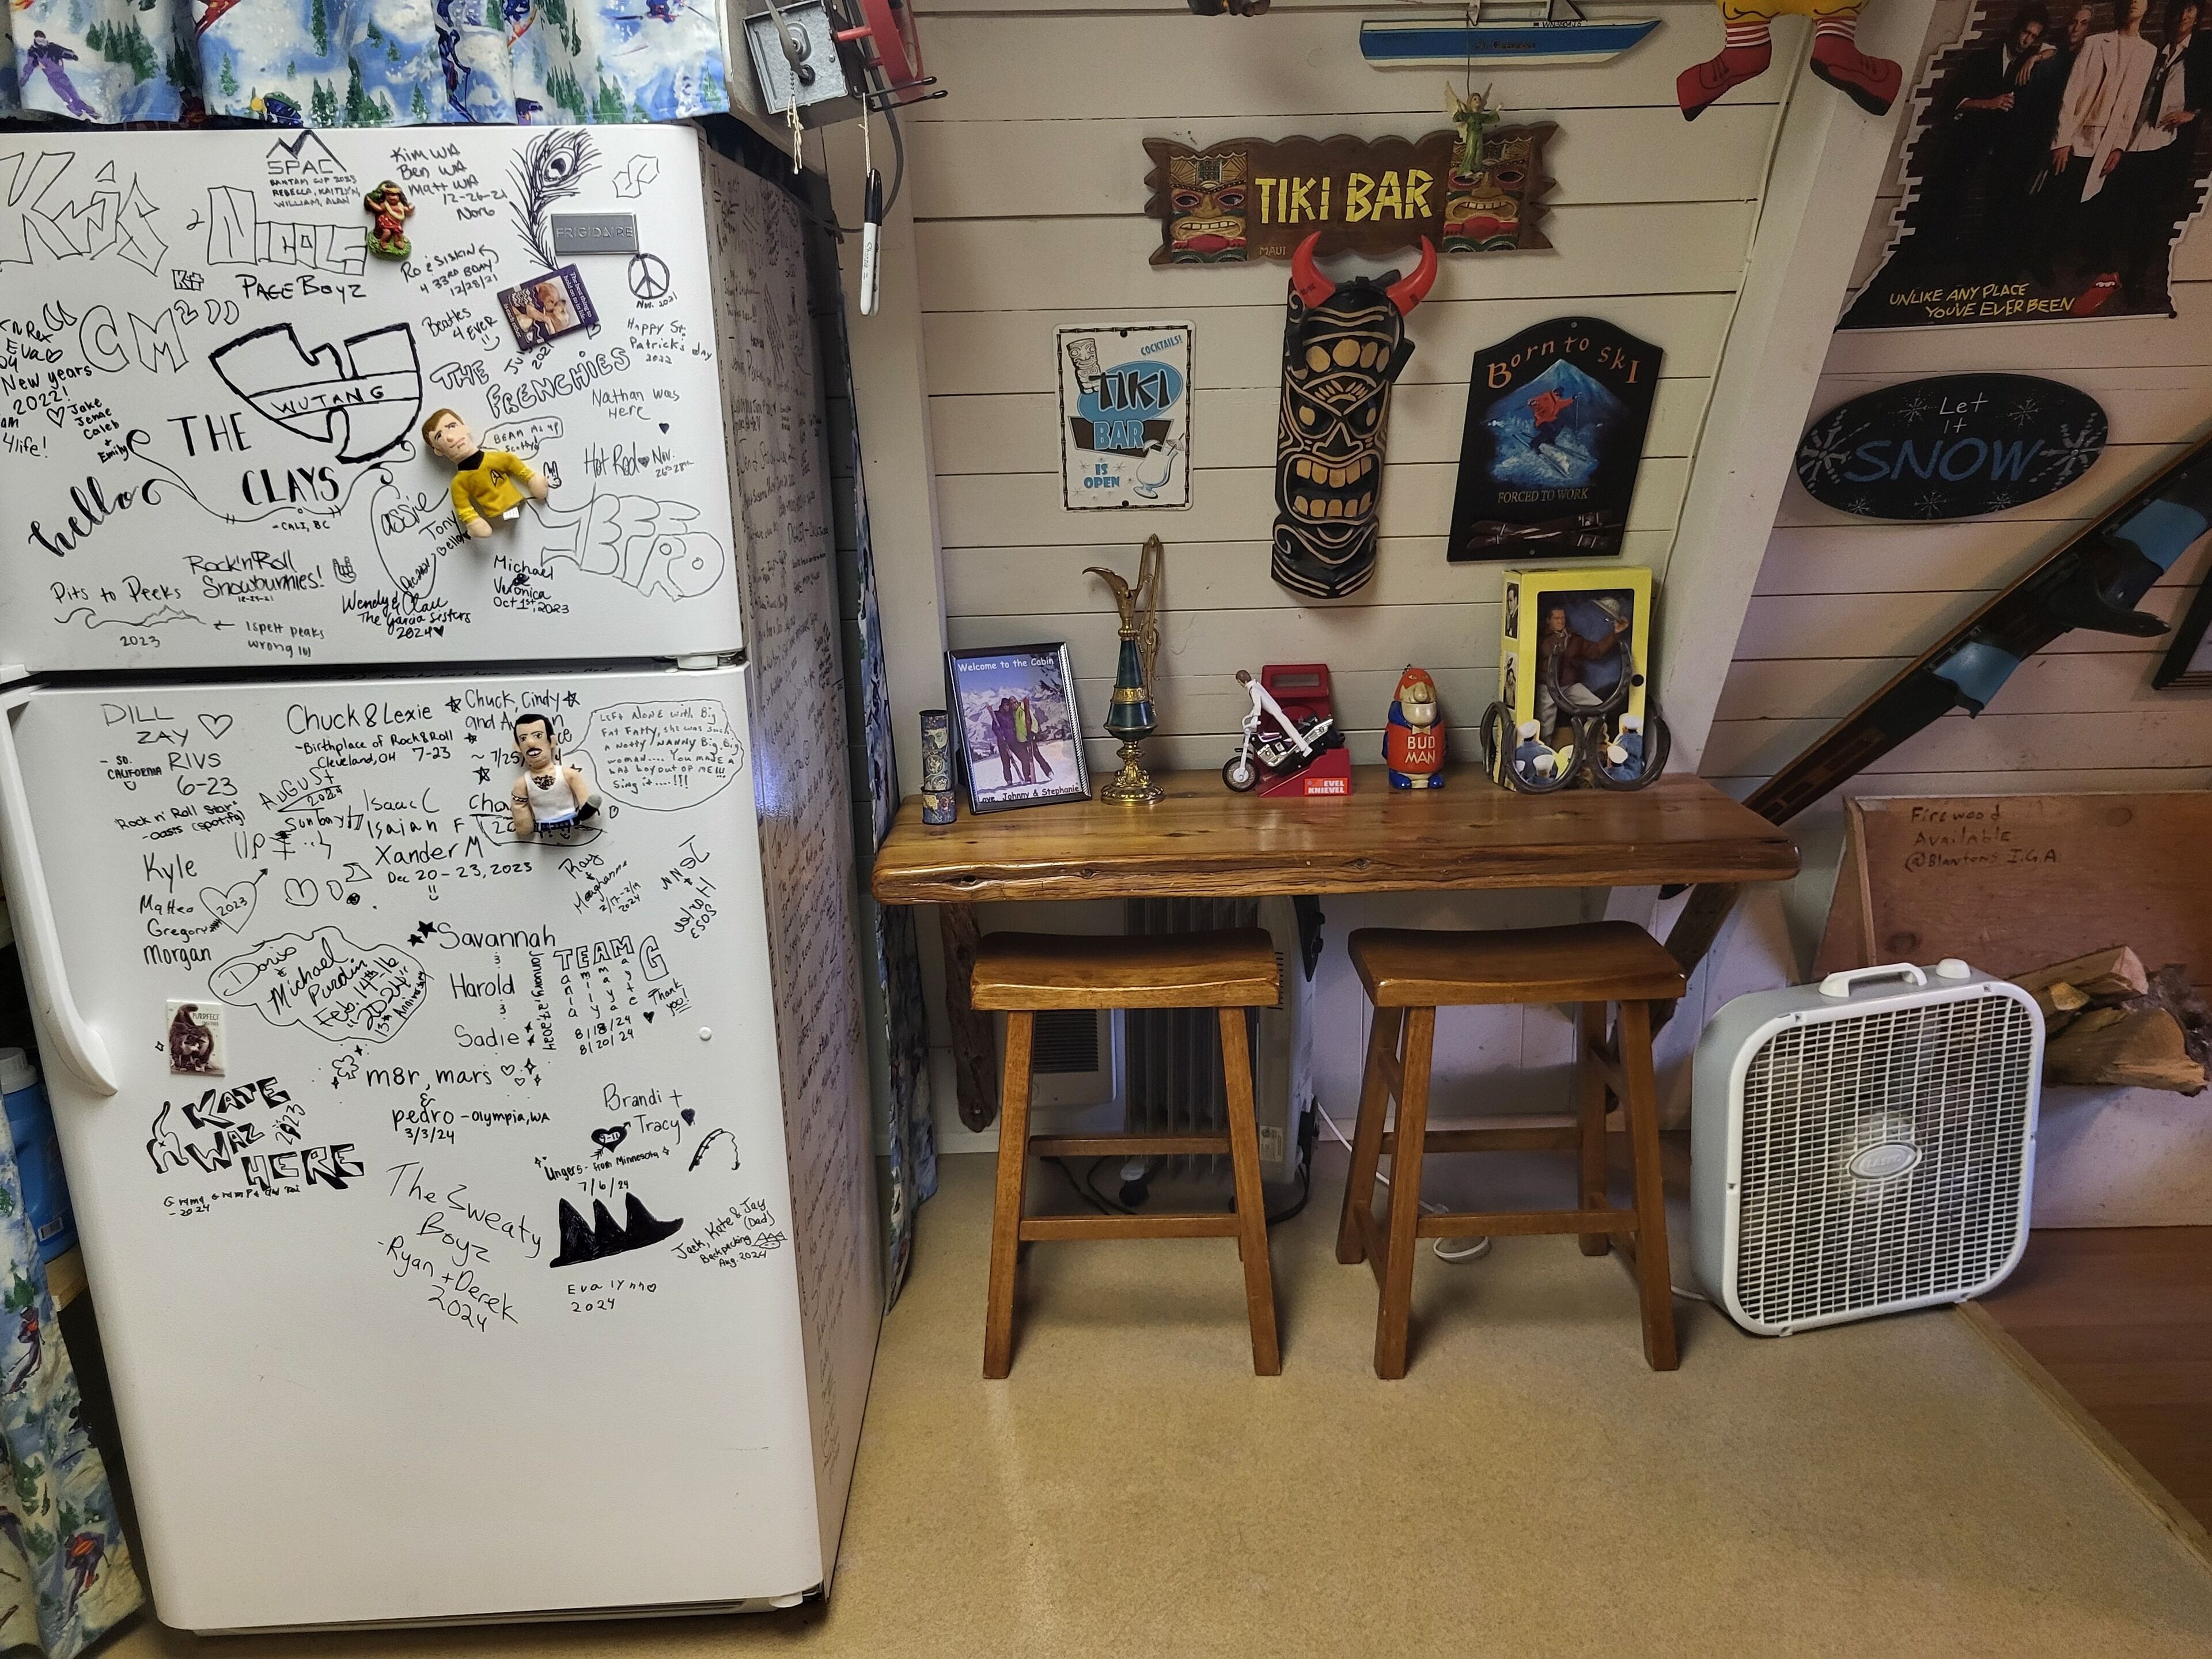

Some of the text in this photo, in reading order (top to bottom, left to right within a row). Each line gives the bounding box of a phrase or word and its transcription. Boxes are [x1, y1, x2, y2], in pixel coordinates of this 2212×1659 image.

[391, 146, 429, 162] Kim
[267, 160, 334, 175] SPAC
[397, 164, 430, 180] Ben
[270, 178, 309, 187] BANTAM
[325, 196, 350, 205] ALAN
[443, 188, 507, 204] 12-26-21
[1255, 169, 1434, 224] TIKI BAR
[556, 226, 634, 238] FRIGIDAIRE
[1259, 245, 1286, 256] MAUI
[450, 274, 498, 296] 12/28/21
[563, 275, 573, 289] hold
[579, 294, 589, 312] thing
[1890, 283, 2031, 306] UNLIKE ANY PLACE
[506, 308, 514, 324] each
[1925, 297, 2075, 319] YOU'VE EVER BEEN
[453, 326, 465, 340] 4
[1141, 335, 1183, 356] COCKTAILS!
[1487, 339, 1555, 389] Born
[1563, 336, 1590, 354] to
[1, 372, 39, 396] New
[430, 359, 490, 392] THE
[486, 347, 631, 419] FRENCHIES
[592, 388, 645, 406] Nathan
[1088, 369, 1172, 411] TIKI
[67, 397, 103, 415] Jake
[1939, 392, 1988, 415] Let
[83, 421, 120, 440] Caleb
[168, 412, 252, 456] THE
[1093, 420, 1145, 450] BAR
[97, 443, 129, 463] Emily
[1843, 437, 2046, 483] SNOW
[1095, 463, 1108, 475] IS
[242, 466, 340, 505] CLAYS
[1084, 476, 1120, 488] OPEN
[1498, 487, 1589, 504] FORCED TO WORK
[314, 520, 331, 529] BC
[419, 510, 464, 540] Tony
[494, 555, 554, 580] Michael
[50, 581, 89, 604] Pits
[100, 582, 116, 602] to
[120, 635, 161, 648] 2023
[248, 639, 294, 658] wrong
[957, 657, 1055, 673] Welcome to the Cabin
[521, 689, 560, 712] Cindy
[101, 704, 175, 727] DILL
[287, 702, 361, 734] Chuck
[384, 702, 433, 725] Lexie
[137, 729, 190, 747] ZAY
[1407, 736, 1435, 749] BUD
[168, 751, 222, 771] RIVS
[412, 747, 451, 762] 7-23
[1404, 750, 1435, 764] MAN
[108, 766, 162, 780] CALIFORNIA
[177, 775, 238, 797] 6-23
[1002, 791, 1029, 802] Johnny
[1033, 789, 1039, 797] &
[1041, 785, 1080, 796] Stephanie
[375, 836, 484, 865] Xander M
[143, 853, 197, 893] Kyle
[217, 897, 248, 917] 2023
[439, 923, 556, 950] Savannah
[143, 945, 213, 971] Morgan
[553, 935, 669, 982] TEAM G
[450, 972, 516, 999] Harold
[192, 1013, 220, 1021] PURRFECT
[454, 1024, 520, 1048] Sadie
[436, 1067, 493, 1085] mars
[182, 1076, 291, 1130] KATE
[603, 1083, 662, 1111] Brandi
[392, 1105, 454, 1134] pedro
[634, 1114, 681, 1145] Tracy
[405, 1127, 455, 1145] 3/3/24
[185, 1122, 265, 1173] WAZ
[241, 1143, 365, 1191] HERE
[616, 1152, 659, 1166] Minnesota
[386, 1162, 542, 1259] The Sweaty
[704, 1218, 734, 1240] Kate
[740, 1196, 766, 1213] Jay
[416, 1211, 491, 1267] Boyz
[738, 1249, 767, 1260] 2024
[427, 1286, 488, 1332] 2024
[572, 1298, 615, 1313] 2024
